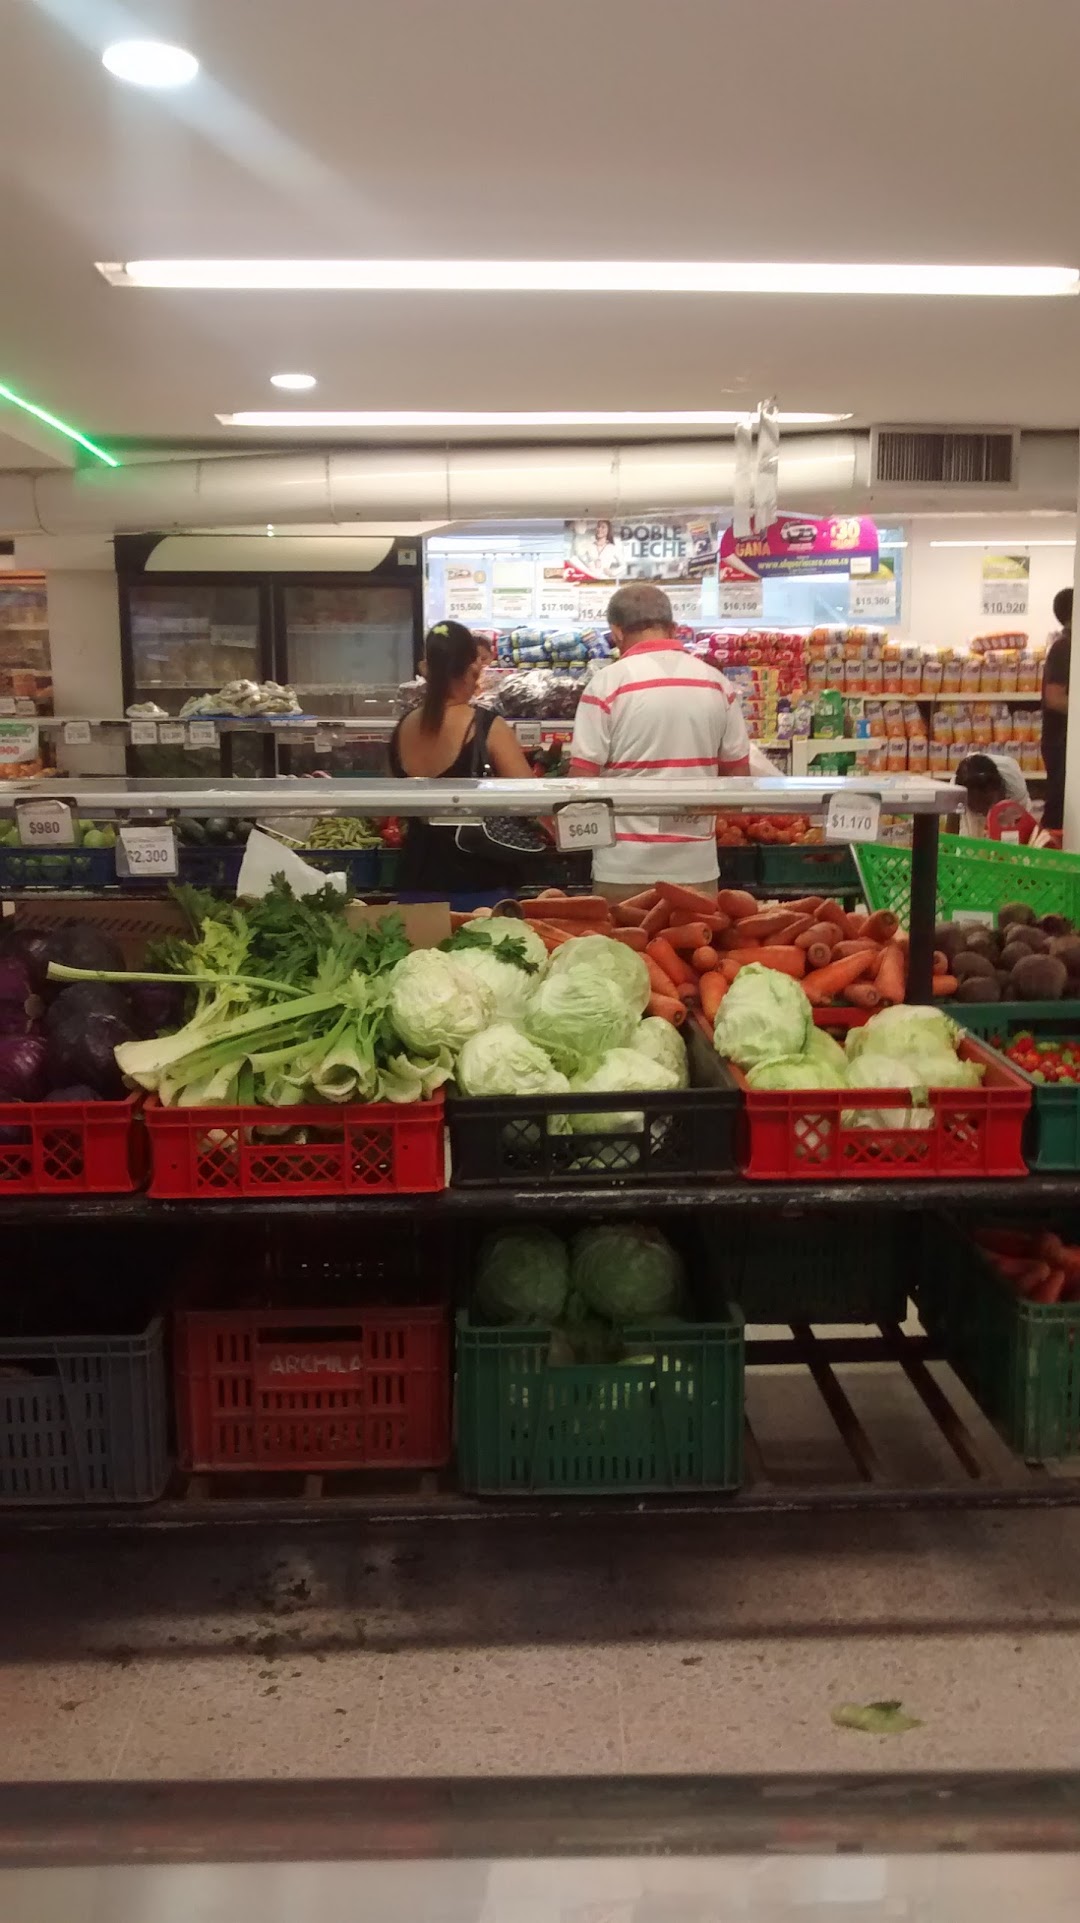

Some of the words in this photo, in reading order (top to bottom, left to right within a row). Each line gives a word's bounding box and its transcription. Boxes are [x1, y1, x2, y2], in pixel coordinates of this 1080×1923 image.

[620, 525, 682, 541] DOBLE
[631, 542, 687, 557] LECHE
[735, 542, 771, 557] GANA
[29, 821, 60, 834] $980
[568, 822, 599, 838] $640
[831, 814, 872, 831] $1.170
[127, 849, 168, 863] $2.300
[269, 1354, 364, 1374] ARCHILA
